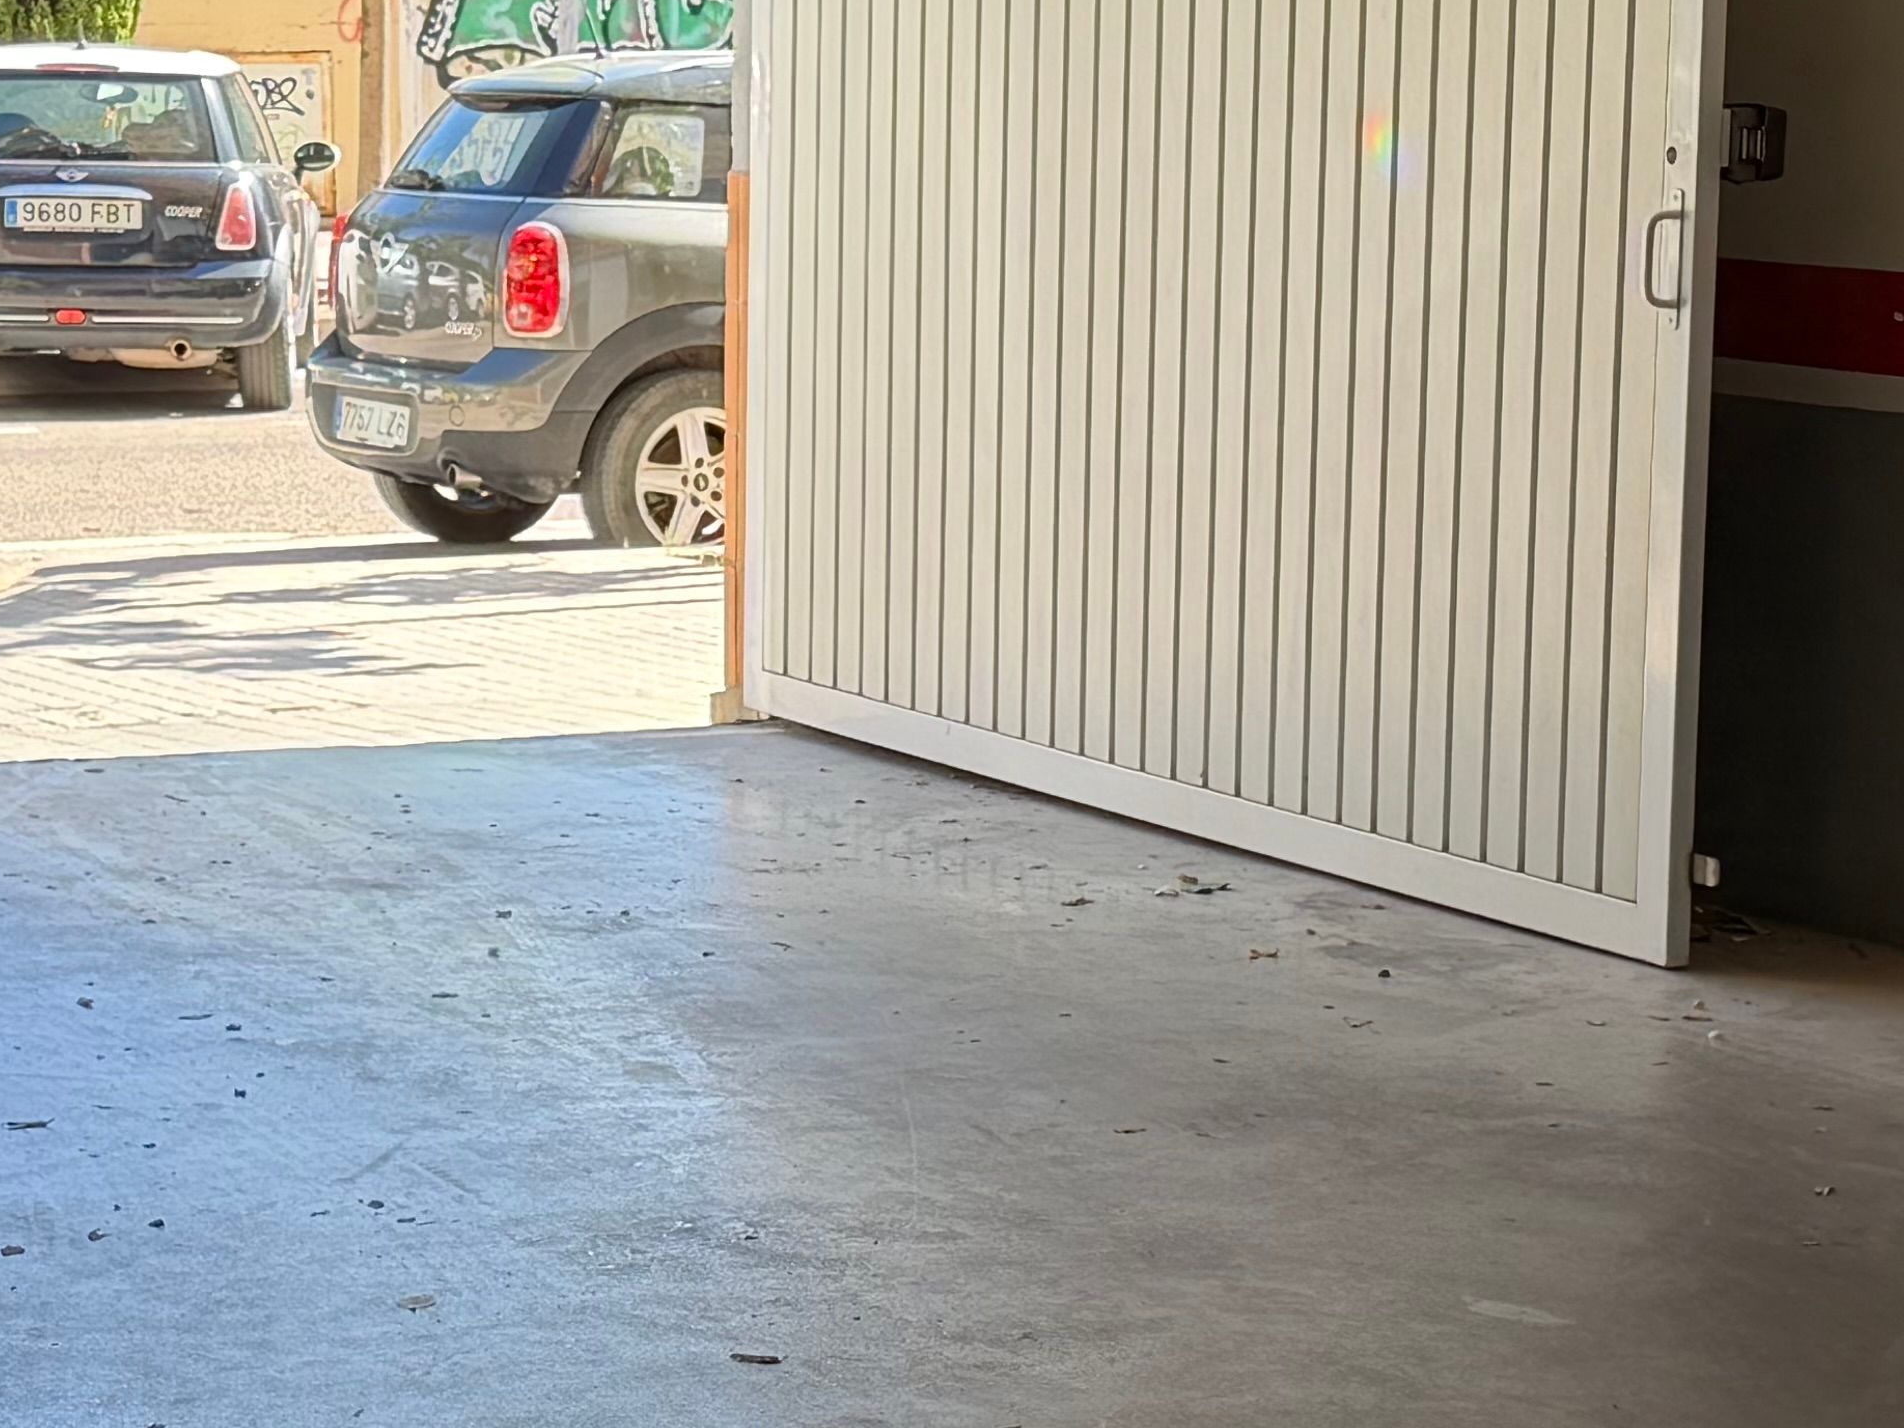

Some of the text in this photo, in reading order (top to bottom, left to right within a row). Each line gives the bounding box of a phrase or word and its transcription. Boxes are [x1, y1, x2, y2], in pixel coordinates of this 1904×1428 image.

[23, 202, 135, 224] 9680 FBT
[164, 205, 203, 218] COOPER
